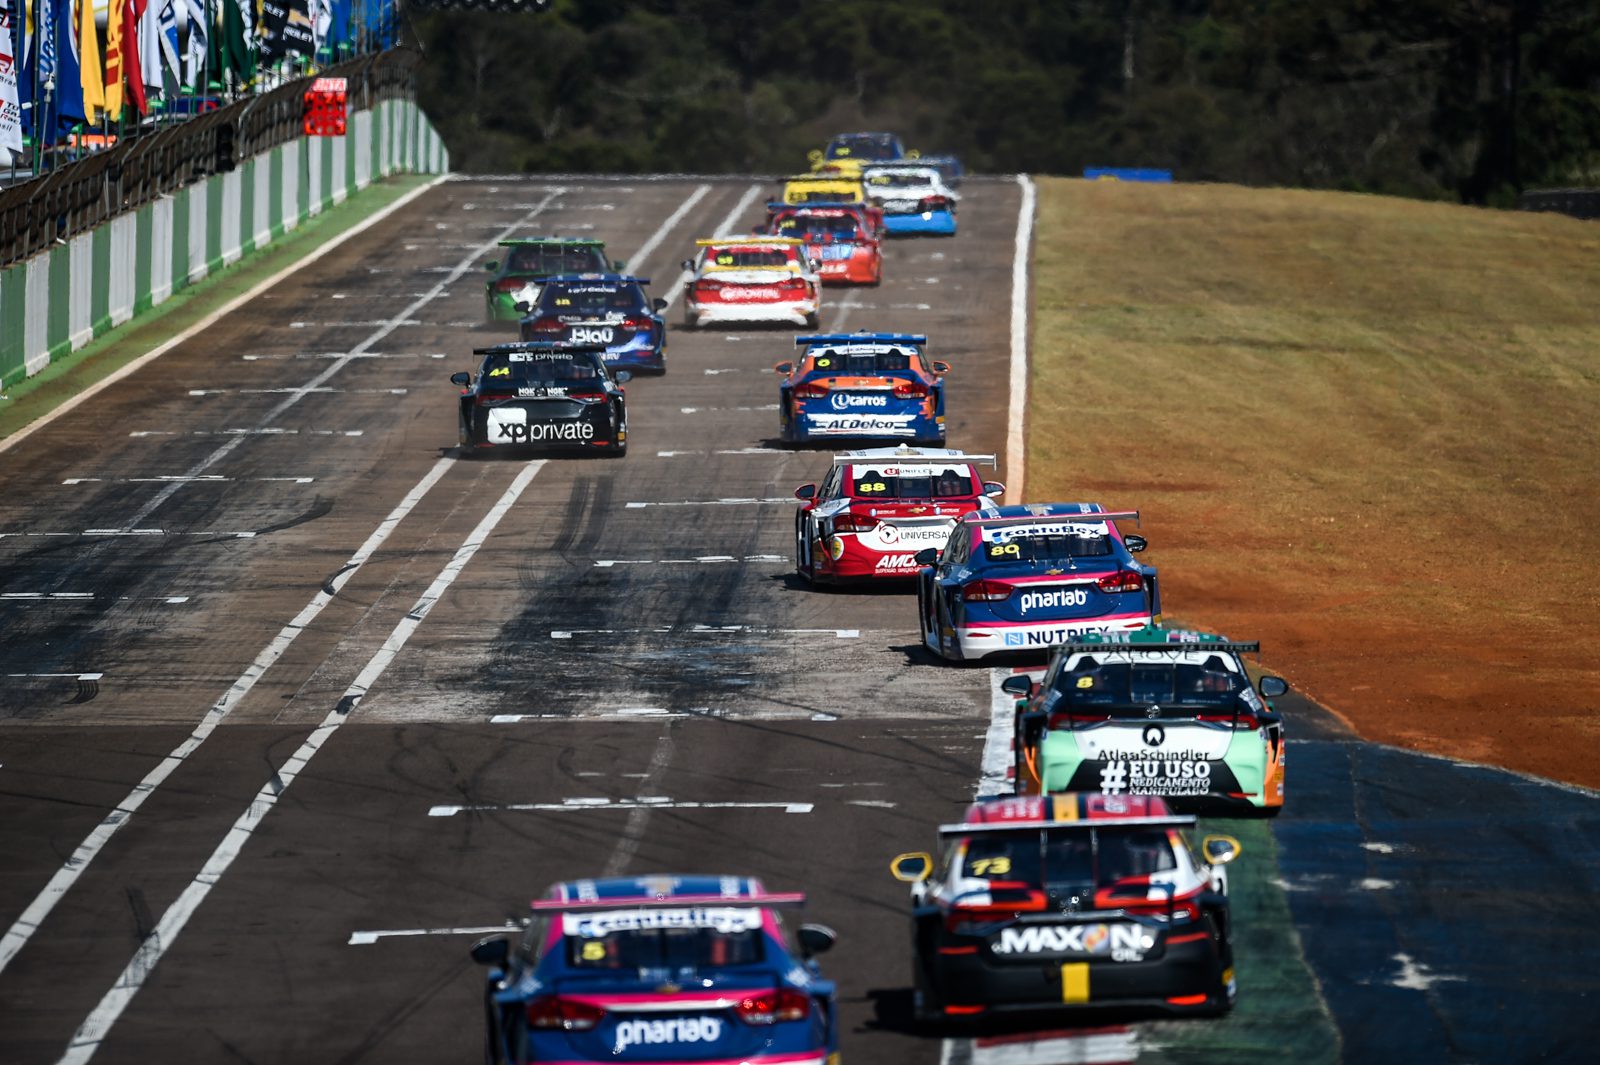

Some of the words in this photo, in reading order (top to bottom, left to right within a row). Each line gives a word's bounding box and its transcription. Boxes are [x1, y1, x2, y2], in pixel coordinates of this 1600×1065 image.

[489, 367, 511, 377] 44
[827, 418, 895, 430] ACDelco
[498, 422, 527, 444] xp
[531, 420, 594, 442] private
[859, 481, 887, 493] 88
[991, 544, 1020, 556] 80
[1076, 676, 1094, 689] 8
[1164, 760, 1211, 778] USO
[1129, 777, 1211, 787] MEDICAMENTO
[970, 856, 1011, 876] 73
